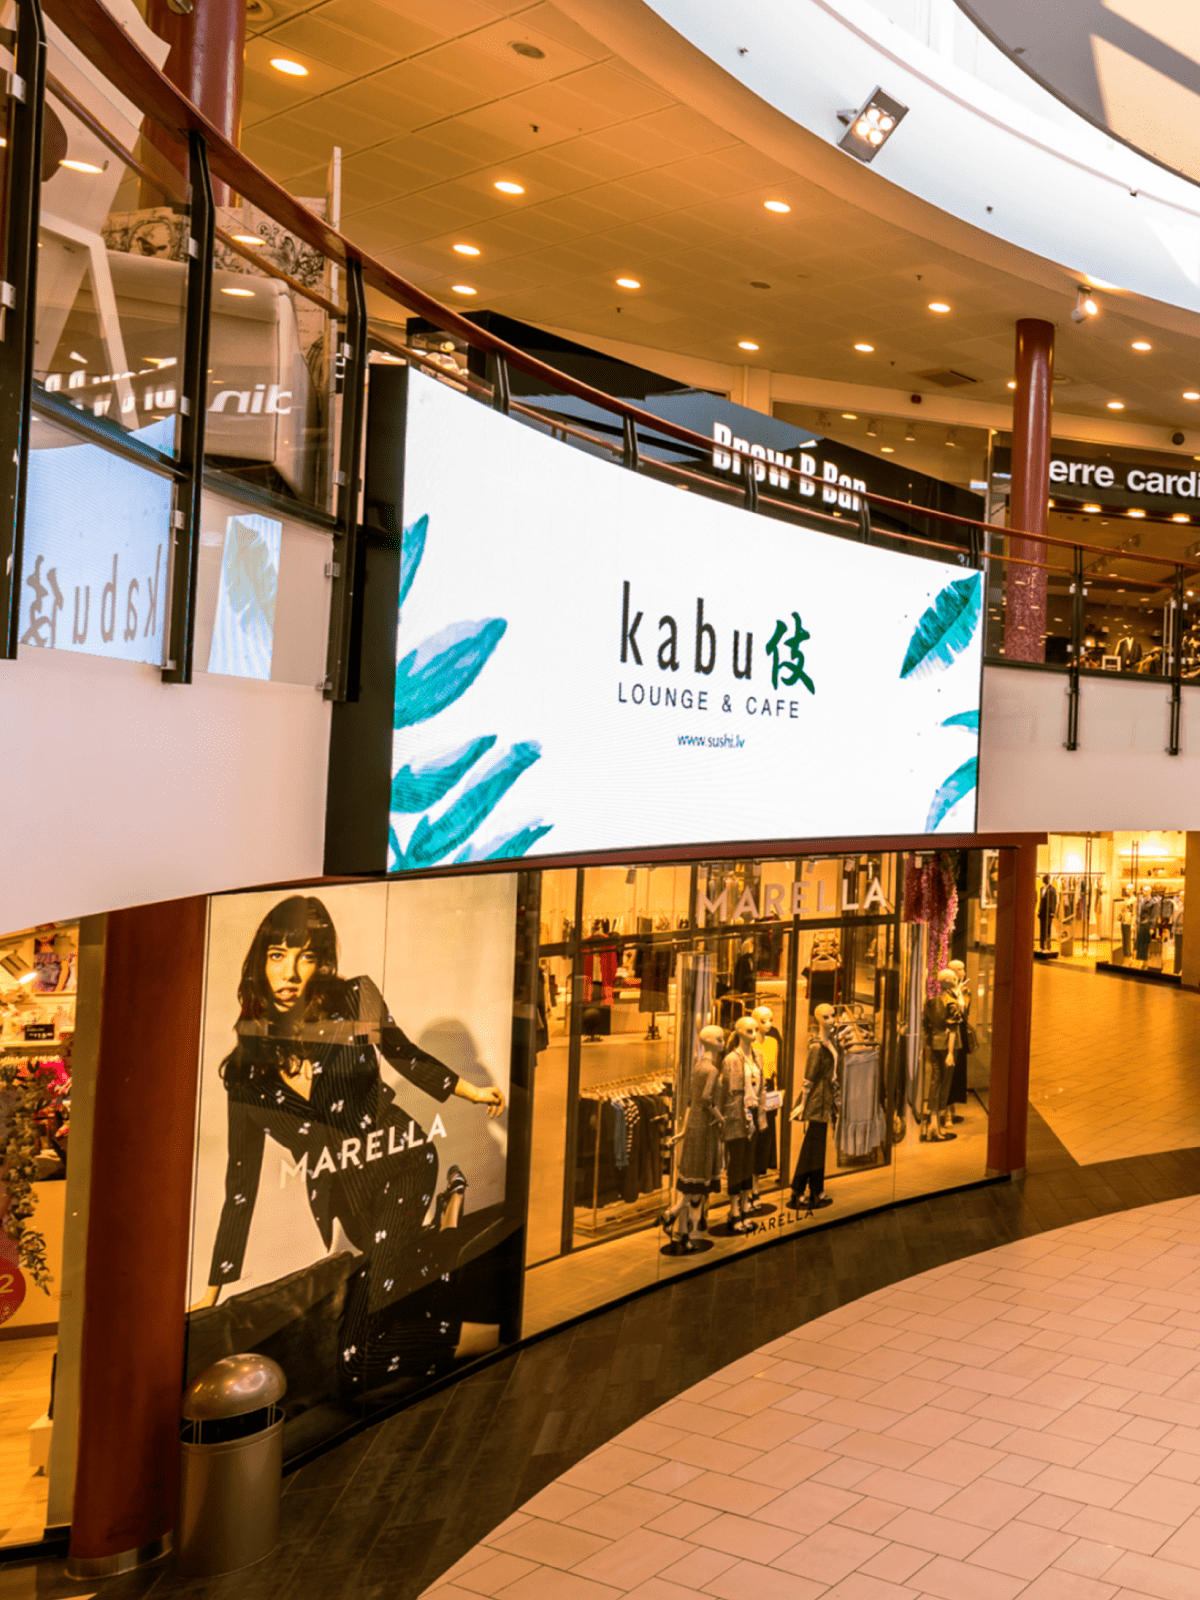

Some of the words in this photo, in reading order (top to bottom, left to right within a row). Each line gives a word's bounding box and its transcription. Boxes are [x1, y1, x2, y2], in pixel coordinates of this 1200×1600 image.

[620, 580, 753, 680] kabu
[618, 682, 708, 710] LOUNGE
[721, 694, 732, 713] &
[746, 696, 799, 719] CAFE
[677, 733, 746, 748] www.sushi.lv
[697, 877, 887, 926] MARELLA
[279, 1113, 447, 1189] MARELLA
